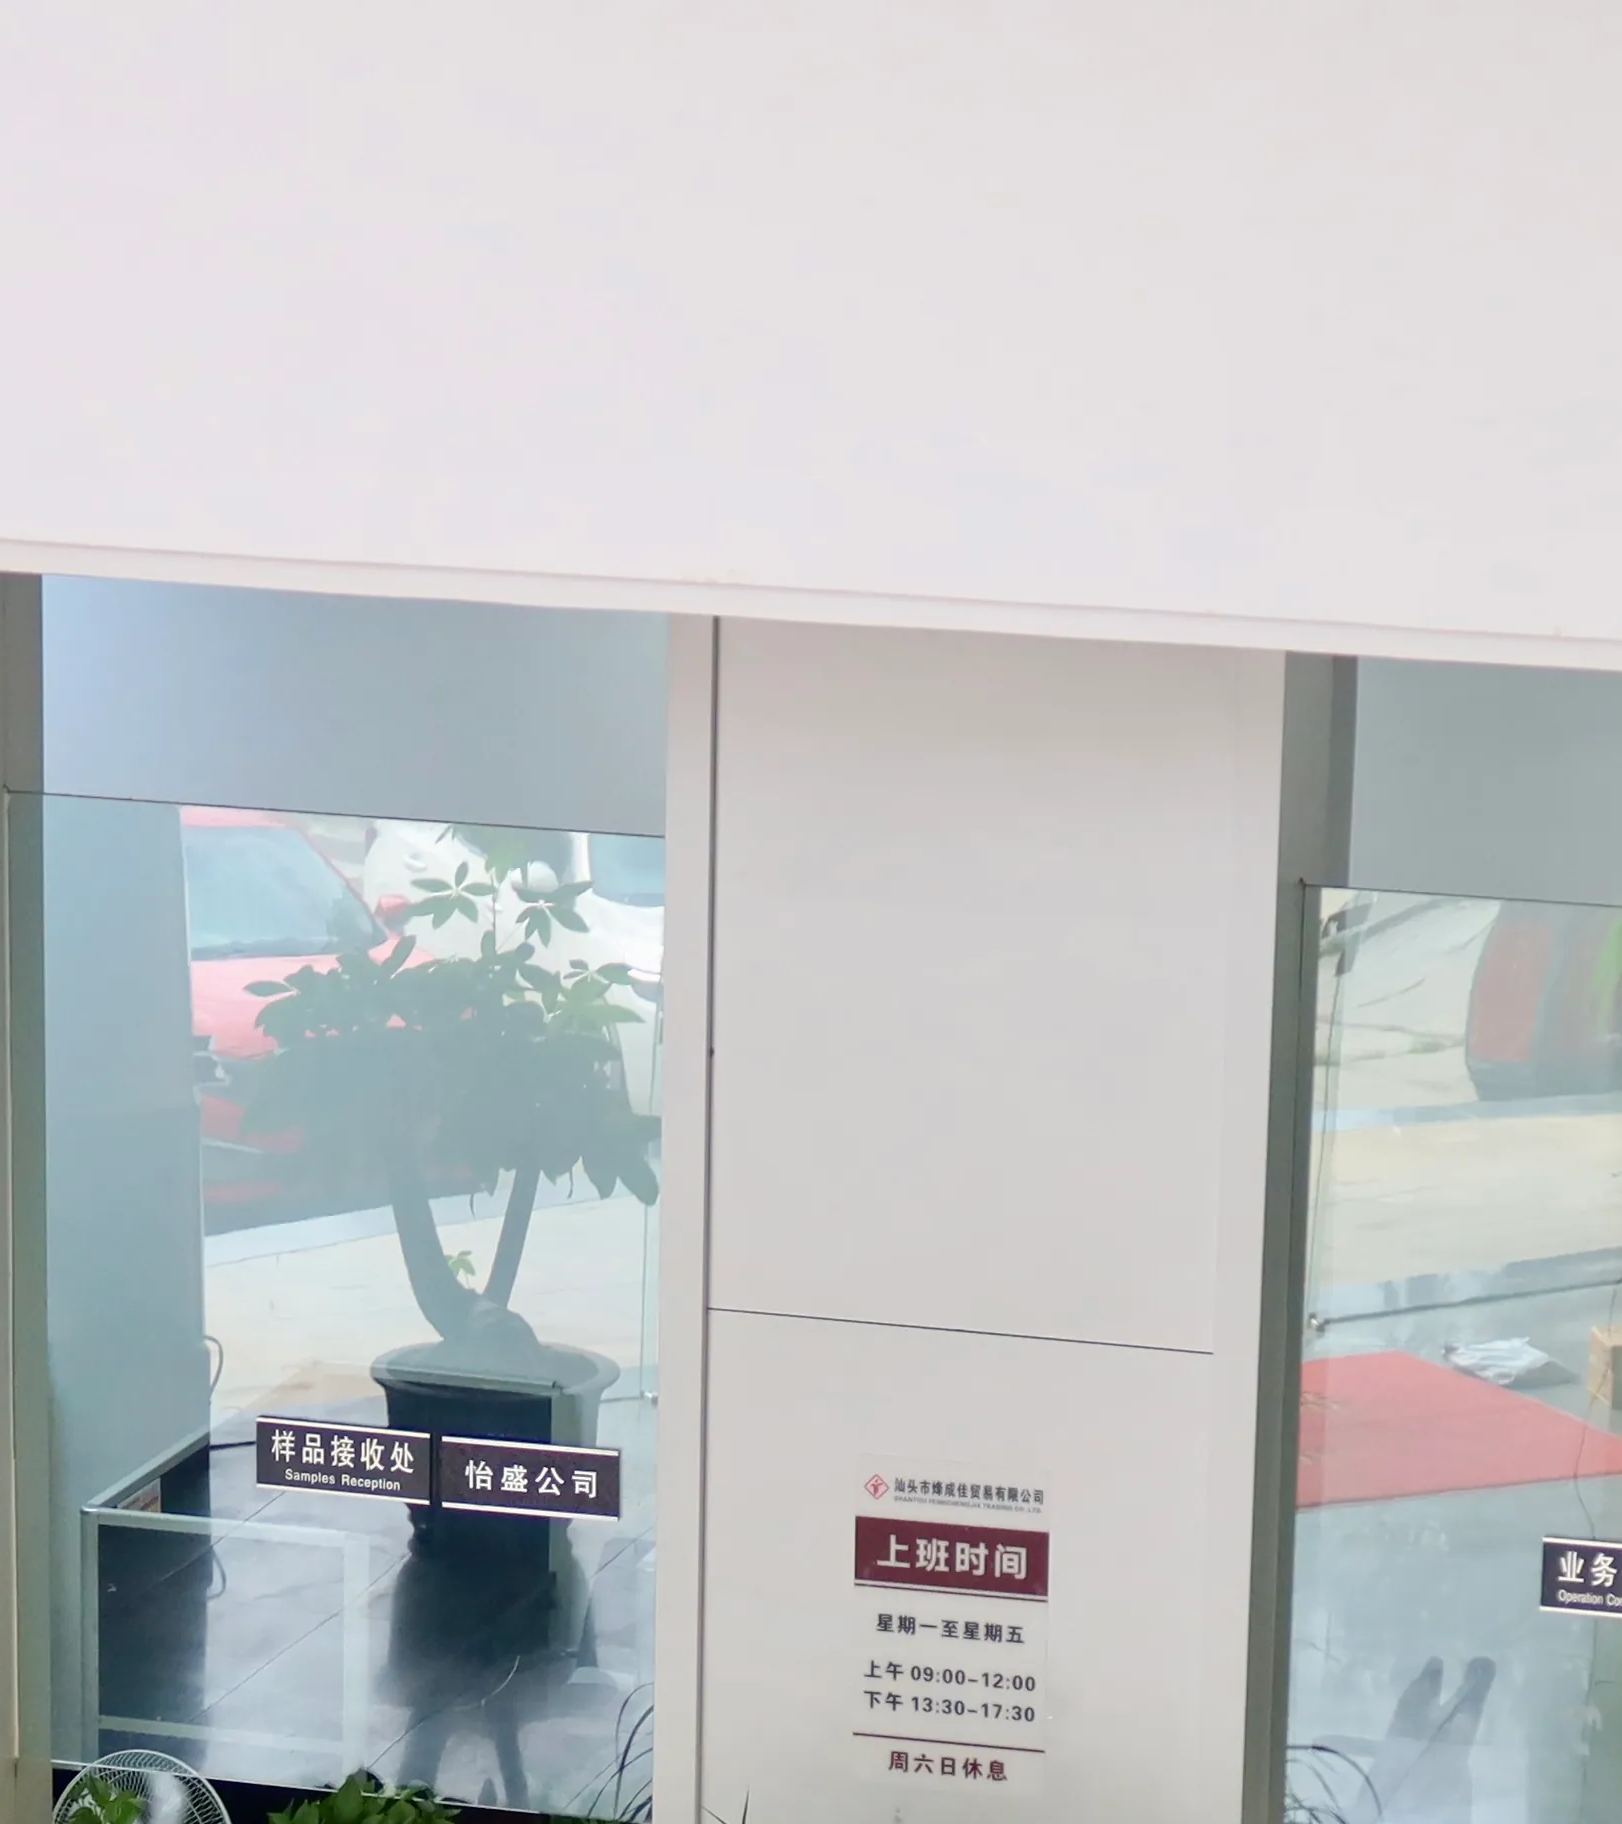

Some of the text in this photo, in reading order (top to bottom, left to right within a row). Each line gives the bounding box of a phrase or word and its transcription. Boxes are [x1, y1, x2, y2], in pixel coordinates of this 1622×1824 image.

[271, 1429, 415, 1474] 样品接收处
[285, 1468, 401, 1491] Samples Reception
[465, 1459, 598, 1499] 怡盛公司
[876, 1534, 1027, 1580] 上班时间
[1558, 1589, 1603, 1605] Operation
[876, 1613, 1025, 1644] 星期一至星期五
[863, 1660, 904, 1681] 上午
[863, 1690, 904, 1711] 下午
[888, 1751, 1008, 1781] 周六日休息
